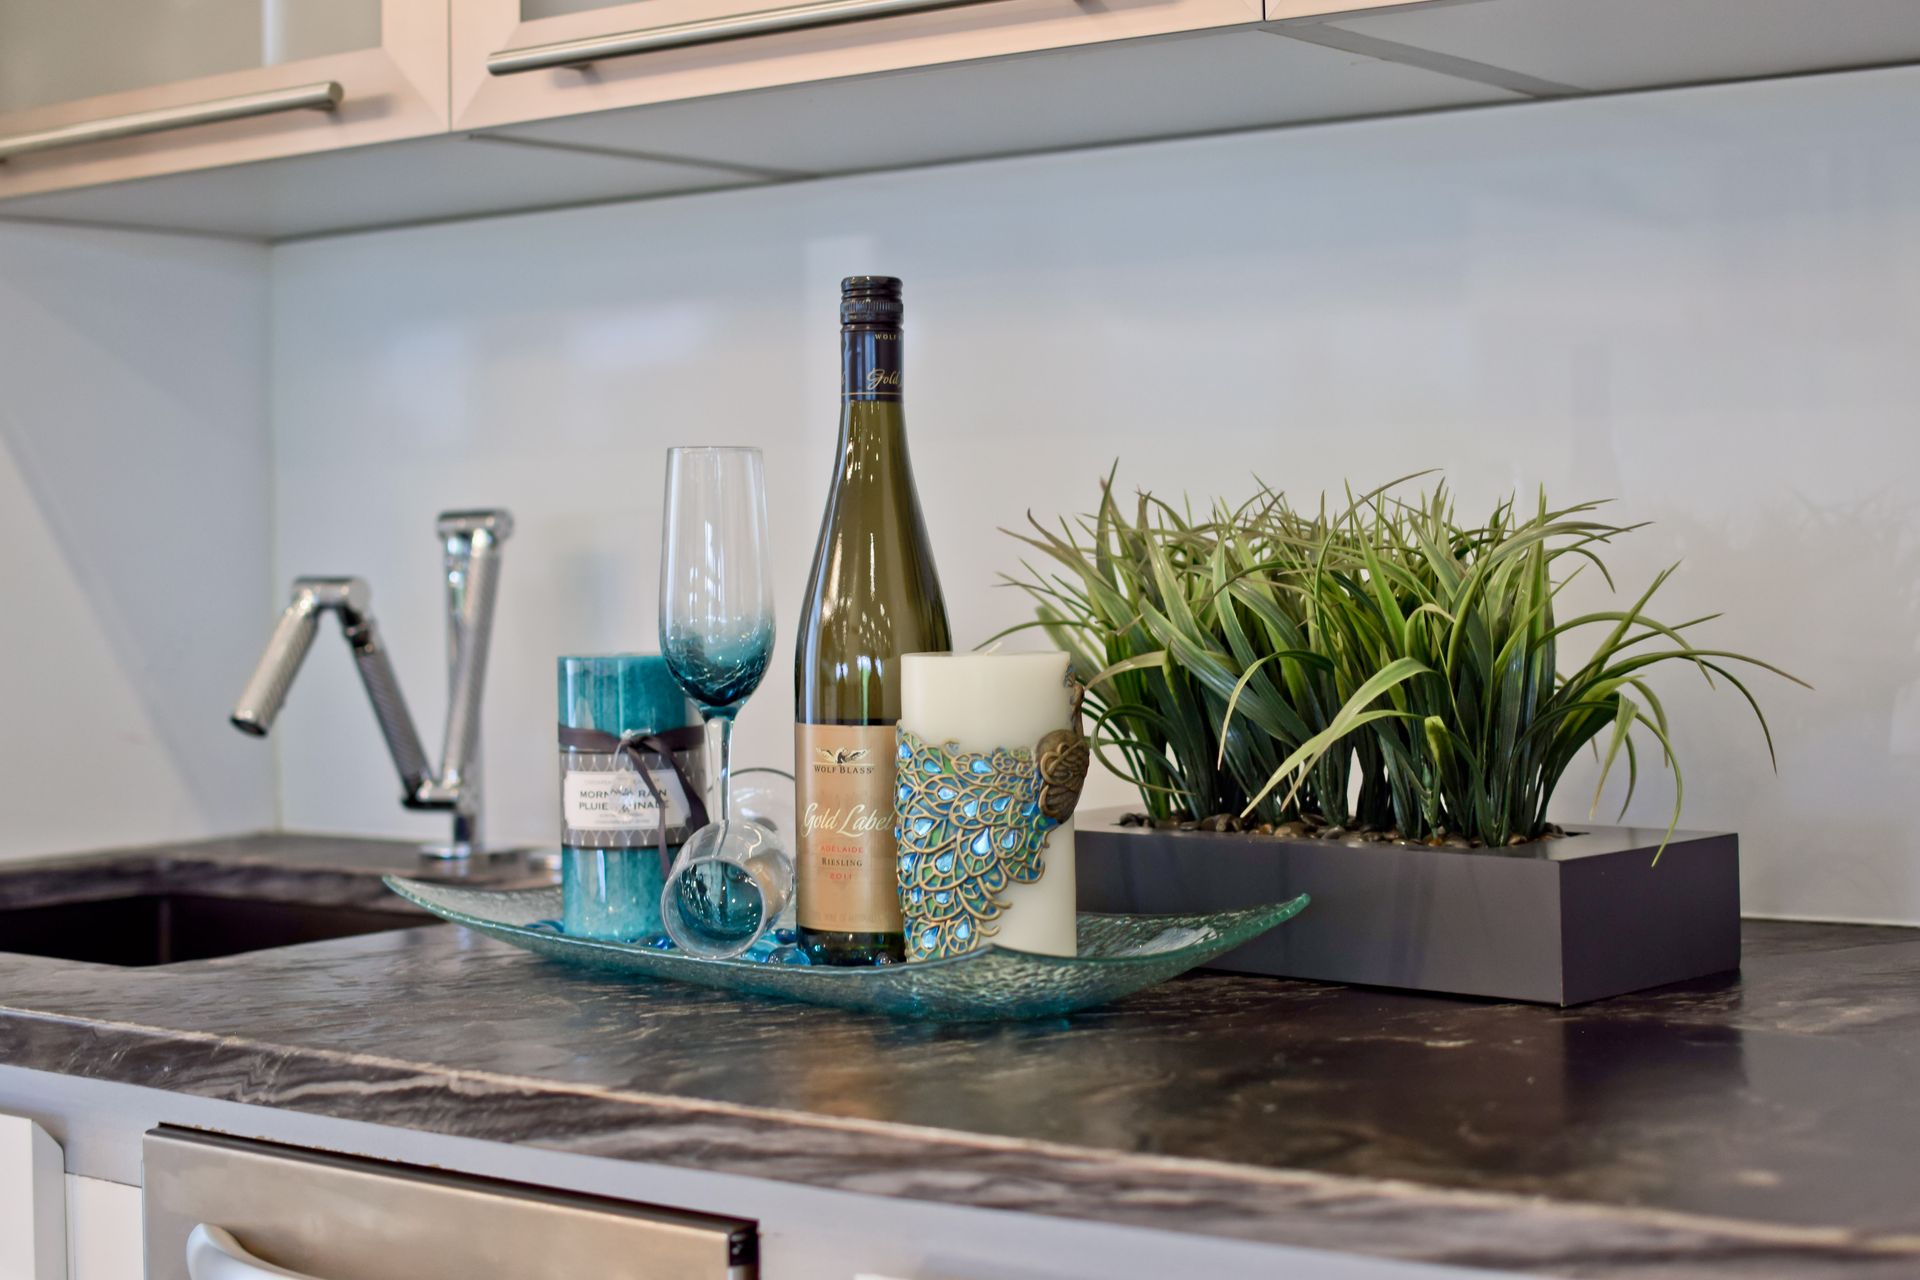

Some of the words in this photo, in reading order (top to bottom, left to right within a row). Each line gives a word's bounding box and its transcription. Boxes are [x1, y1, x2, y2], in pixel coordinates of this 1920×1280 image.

[866, 368, 898, 390] Gold
[814, 765, 836, 773] WOLF
[839, 766, 873, 774] BLASS
[579, 801, 608, 811] PLUIE
[801, 802, 841, 837] Gold
[836, 803, 896, 837] Label
[820, 845, 863, 853] ADELAIDE
[822, 856, 862, 866] RIESLING
